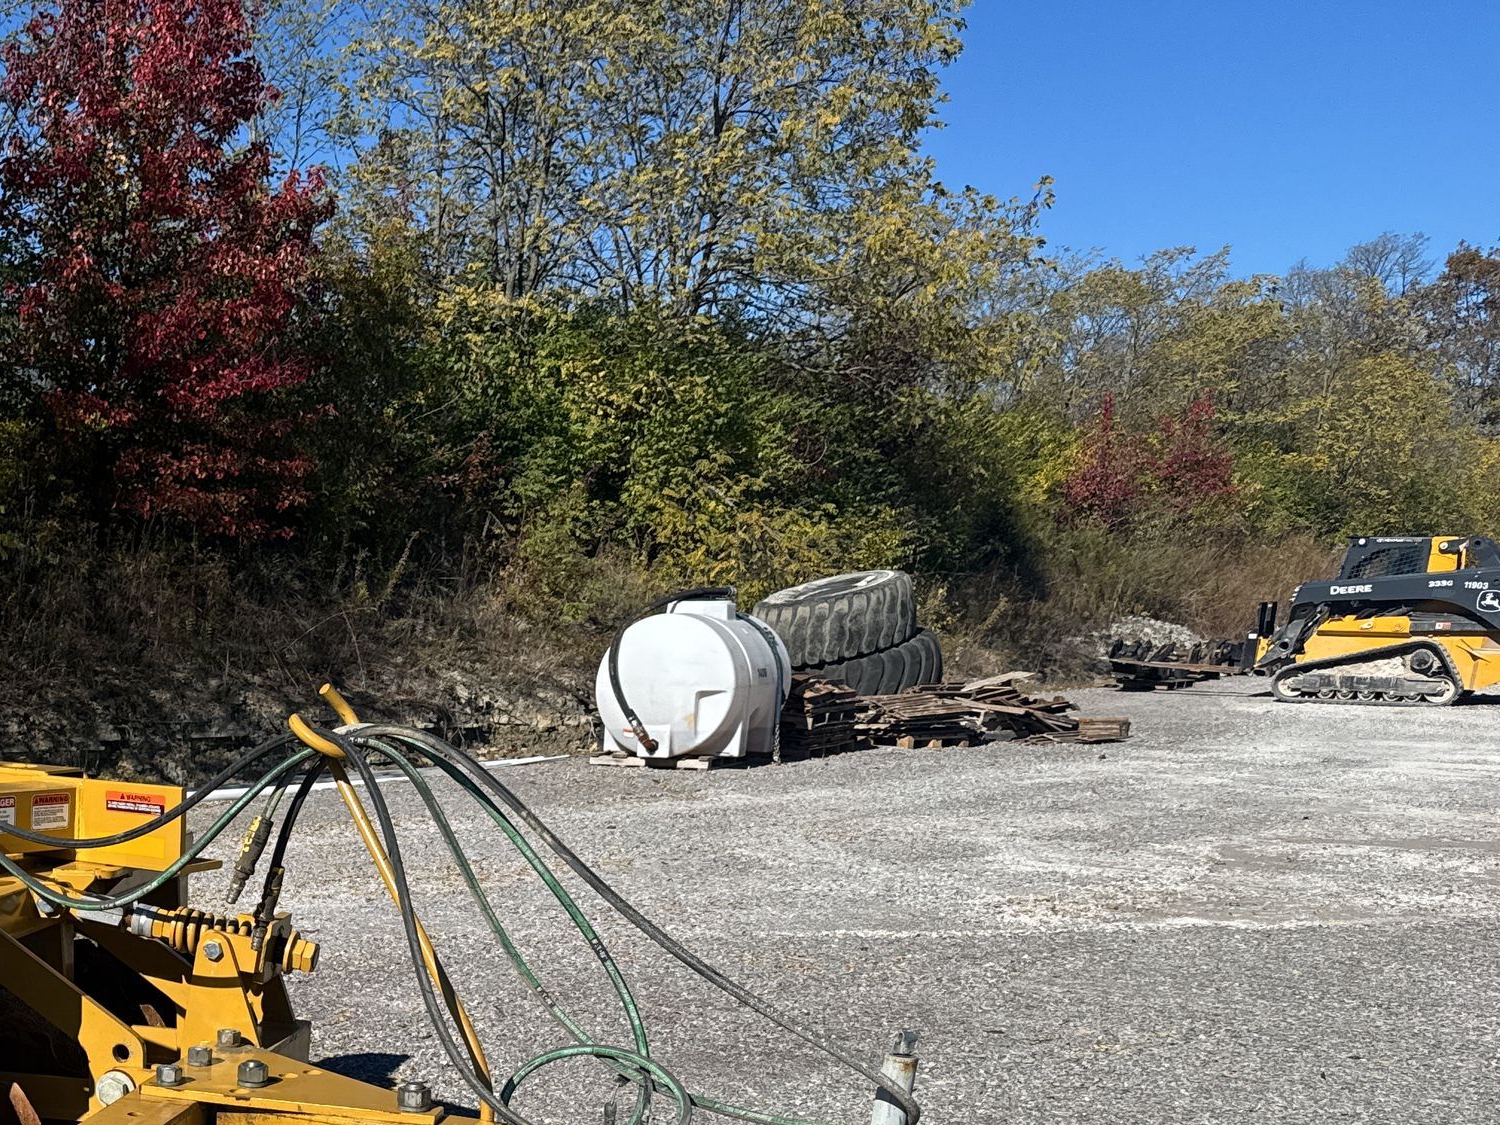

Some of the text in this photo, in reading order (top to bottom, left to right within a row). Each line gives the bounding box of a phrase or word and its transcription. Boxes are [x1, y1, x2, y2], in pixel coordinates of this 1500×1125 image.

[1330, 584, 1373, 596] DEERE
[1464, 581, 1489, 590] 11903
[38, 795, 69, 804] WARNING
[126, 794, 151, 803] WARNING
